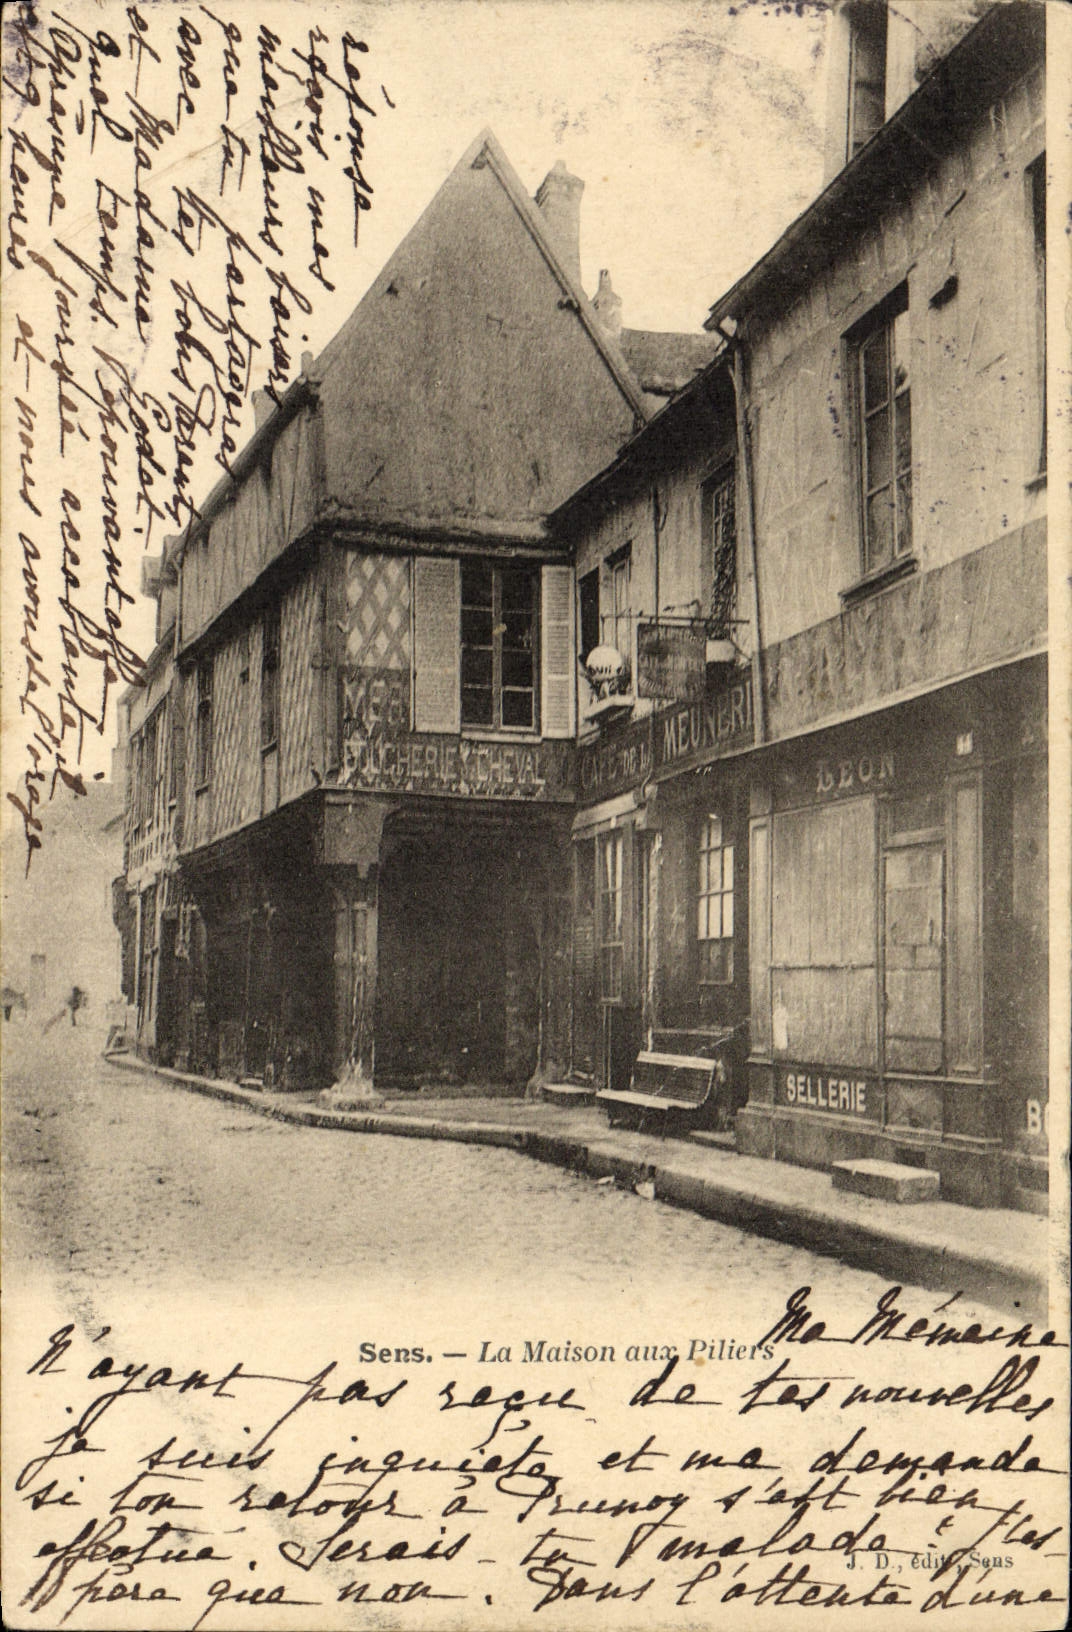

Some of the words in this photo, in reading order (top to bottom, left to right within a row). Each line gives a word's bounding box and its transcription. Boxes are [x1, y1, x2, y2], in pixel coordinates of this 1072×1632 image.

[126, 6, 161, 97] et
[176, 17, 202, 130] avec
[200, 6, 242, 121] que
[307, 186, 335, 291] mes
[15, 397, 43, 517] nous
[786, 1073, 867, 1113] SELLERIE
[139, 1427, 275, 1470] suis
[598, 1436, 670, 1472] et
[249, 1362, 410, 1455] pas
[439, 1380, 586, 1450] reçu
[630, 1356, 722, 1405] de
[841, 1354, 1055, 1420] nouvelles
[192, 1579, 322, 1630] que
